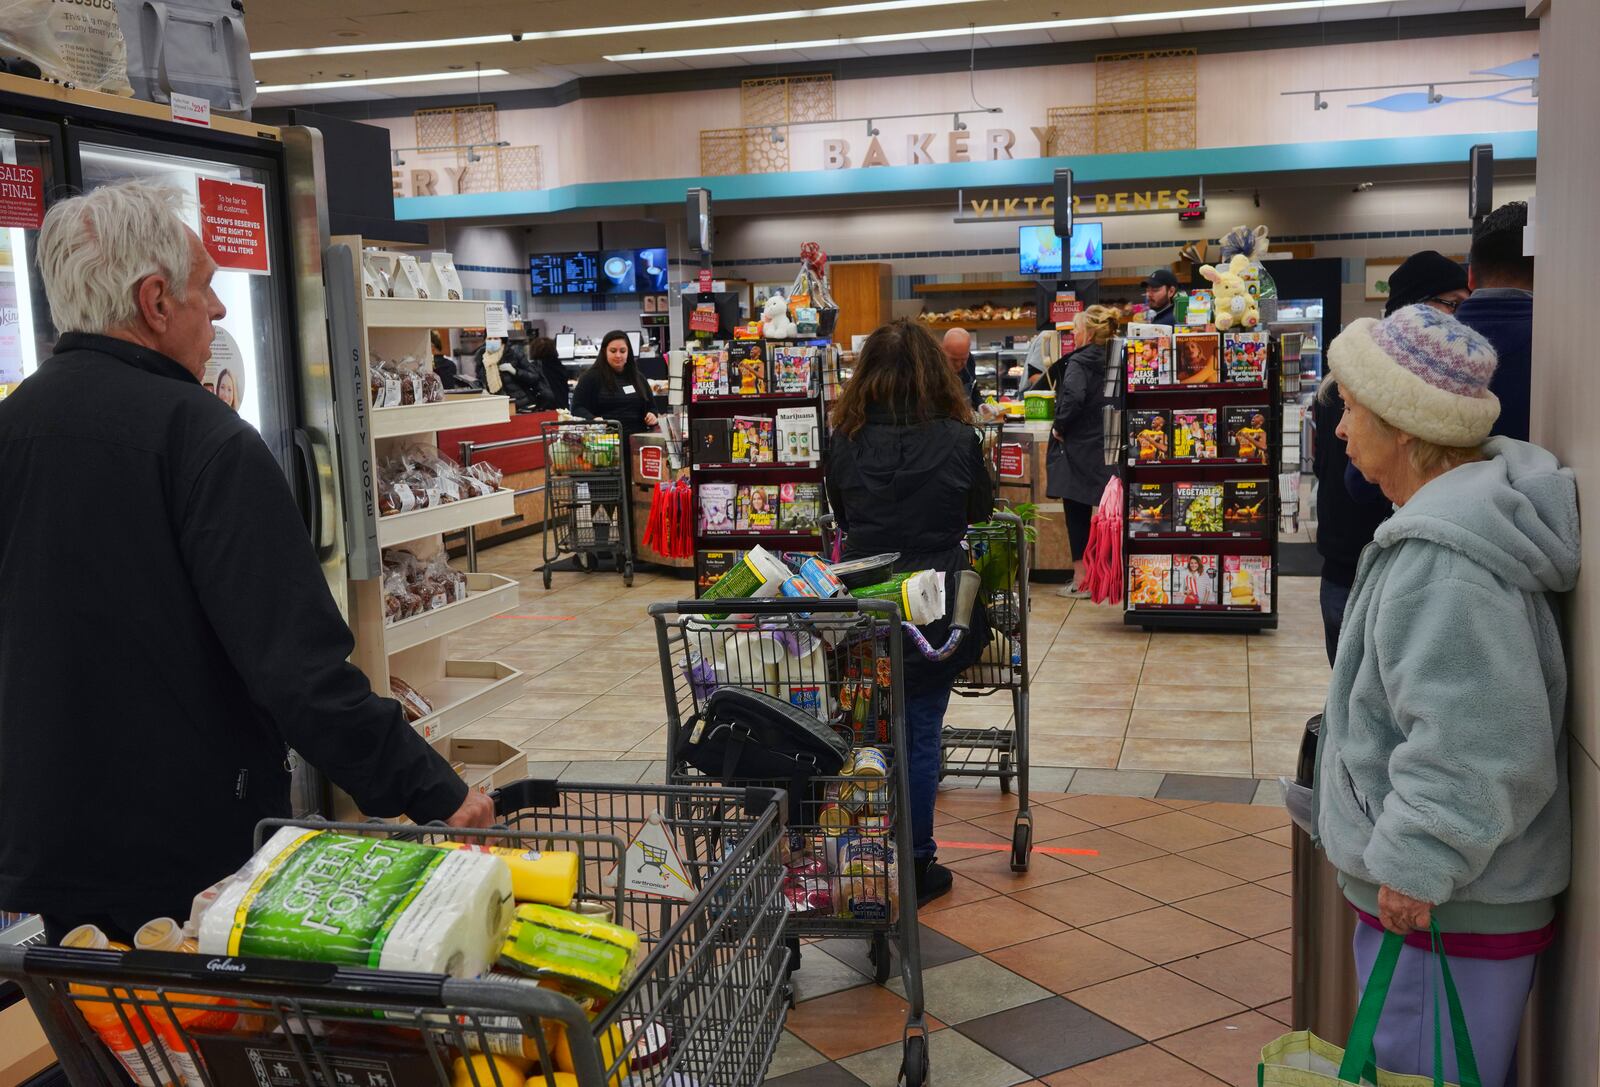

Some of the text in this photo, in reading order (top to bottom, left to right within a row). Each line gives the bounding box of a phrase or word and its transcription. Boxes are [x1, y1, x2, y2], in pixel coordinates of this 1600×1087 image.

[822, 125, 1058, 171] BAKERY
[0, 166, 34, 183] SALES
[1, 183, 36, 200] FINAL
[225, 195, 232, 203] be
[232, 196, 240, 204] fair
[1096, 188, 1191, 214] BENES
[206, 215, 260, 229] GELSON'S RESERVES
[216, 226, 252, 237] THE RIGHT TO
[211, 235, 258, 246] LIMIT QUANTITIES
[217, 244, 254, 255] ON ALL ITEMS
[1128, 377, 1146, 385] DON'T
[1134, 370, 1154, 378] PLEASE
[353, 349, 366, 445] SAFETY
[780, 413, 814, 421] Marijuana
[362, 460, 373, 517] CONE
[1177, 487, 1222, 496] VEGETABLES
[1173, 555, 1216, 567] SHPE
[283, 834, 365, 913] GREEN
[300, 839, 401, 935] FOREST
[206, 957, 247, 972] Gelson's
